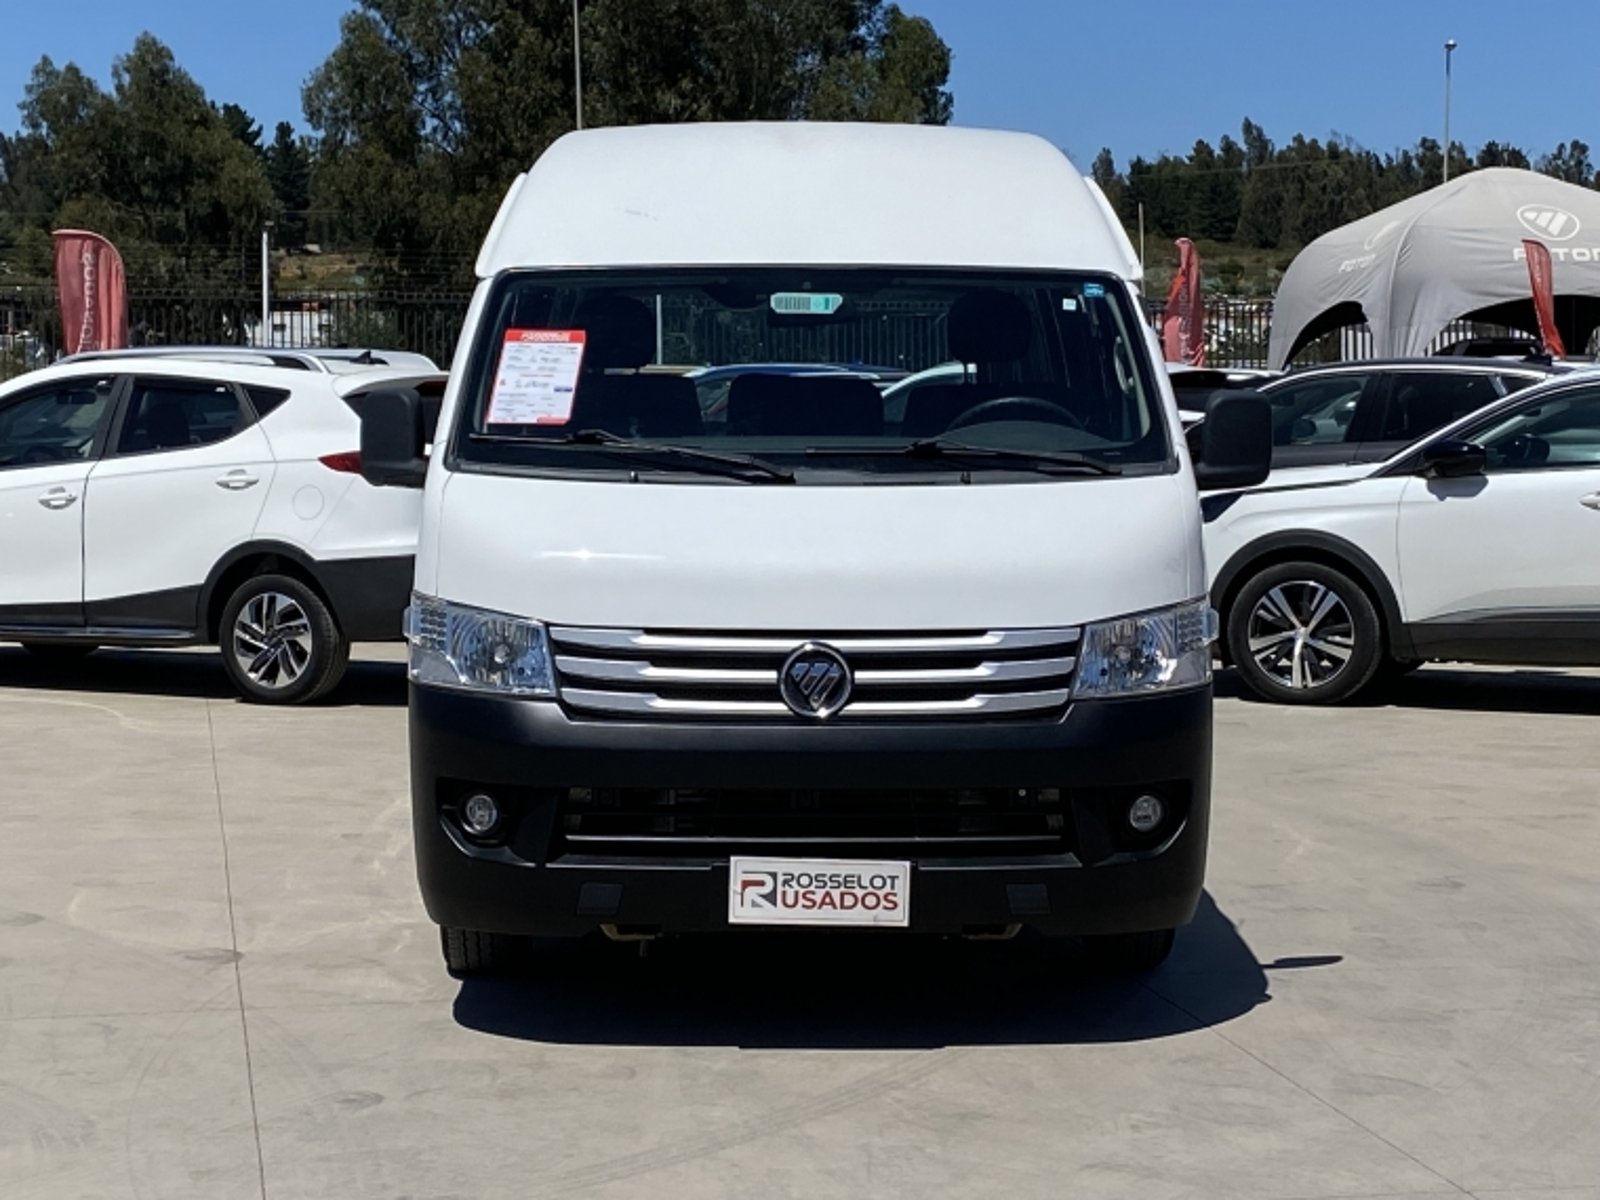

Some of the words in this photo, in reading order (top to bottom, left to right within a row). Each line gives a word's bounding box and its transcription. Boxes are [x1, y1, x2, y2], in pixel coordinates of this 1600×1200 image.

[1513, 247, 1600, 262] FTO
[781, 872, 899, 891] ROSSELOT
[781, 889, 899, 911] USADOS
